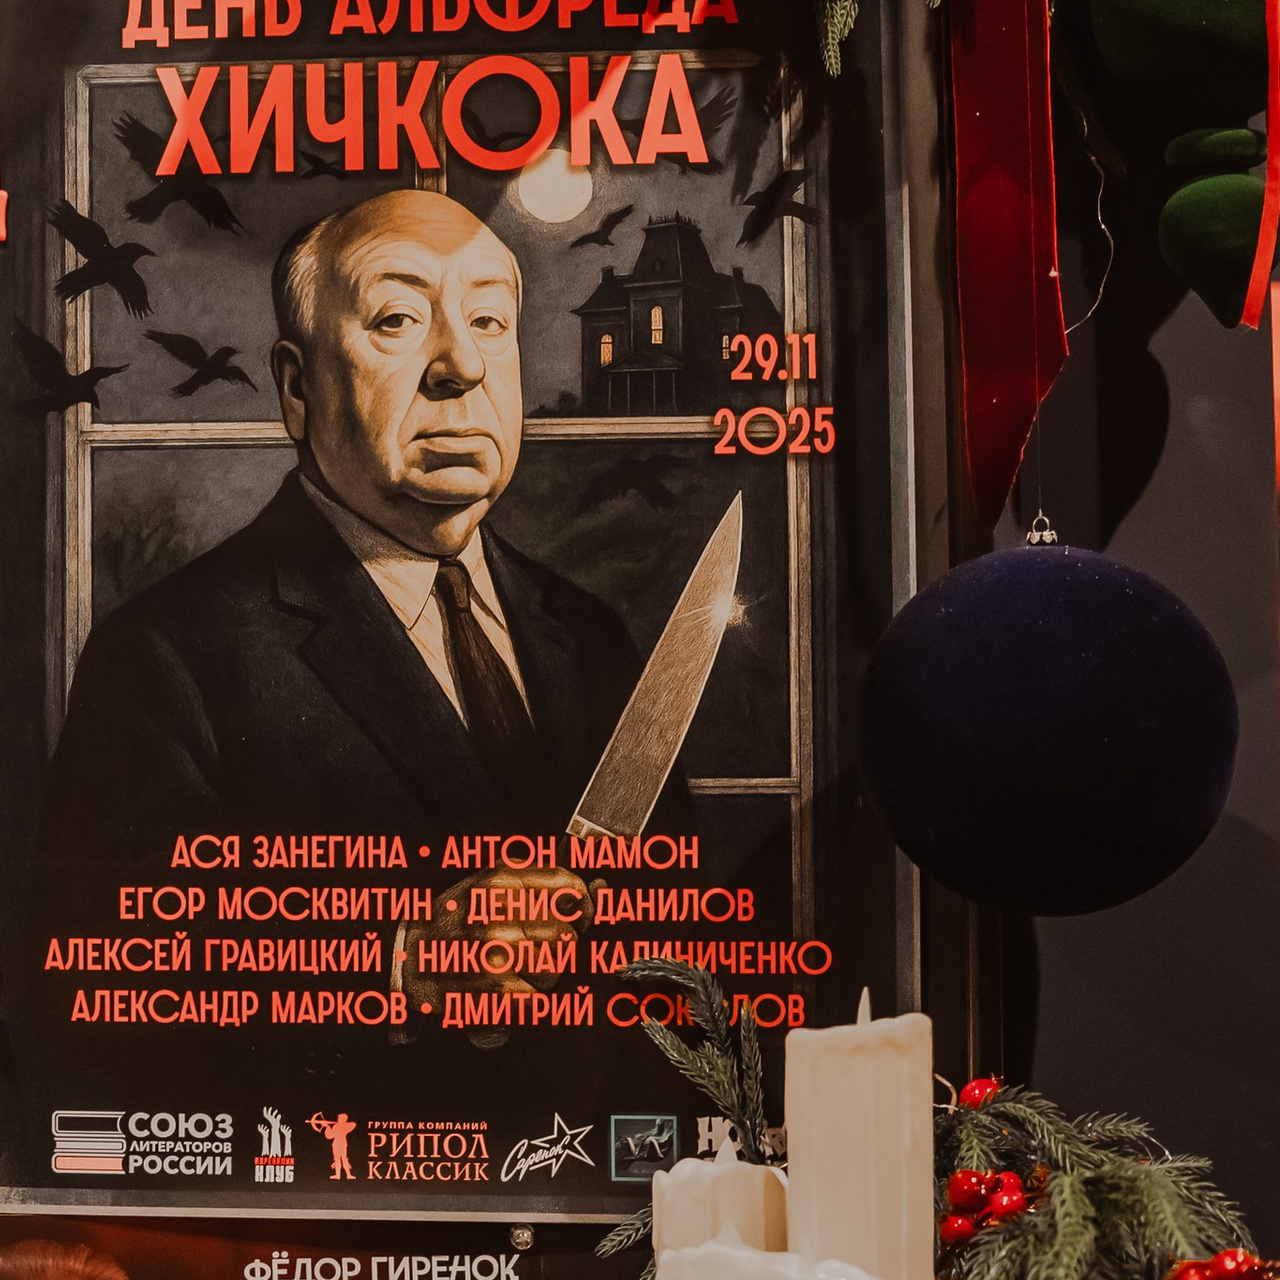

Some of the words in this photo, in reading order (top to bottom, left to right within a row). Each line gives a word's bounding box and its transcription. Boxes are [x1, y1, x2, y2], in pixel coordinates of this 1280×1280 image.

[155, 53, 710, 176] ХИЧКОКА
[730, 333, 817, 381] 29.11
[713, 406, 836, 456] 2025
[171, 834, 241, 869] АСЯ
[252, 835, 409, 869] ЗАНЕГИНА
[441, 835, 557, 870] АНТОН
[569, 834, 699, 870] МАМОН
[120, 886, 206, 921] ЕГОР
[218, 886, 432, 921] МОСКВИТИН
[467, 887, 584, 925] ДЕНИС
[593, 887, 755, 925] ДАНИЛОВ
[44, 930, 192, 972] АЛЕКСЕЙ
[204, 931, 382, 976] ГРАВИЦКИЙ
[418, 933, 577, 975] НИКОЛАЙ
[71, 989, 259, 1027] АЛЕКСАНДР
[271, 990, 409, 1026] МАРКОВ
[442, 985, 594, 1029] ДМИТРИЙ
[606, 992, 806, 1029] СОКЛОВ
[128, 1112, 234, 1139] СОЮЗ
[368, 1121, 414, 1130] ГРУППА
[418, 1121, 488, 1131] КОМПАНИЙ
[129, 1141, 232, 1154] ЛИТЕРАТОРОВ
[367, 1132, 490, 1159] РИПОЛ
[128, 1155, 233, 1176] РОССИИ
[254, 1165, 295, 1183] КЛУБ
[366, 1160, 489, 1181] КЛАССИК
